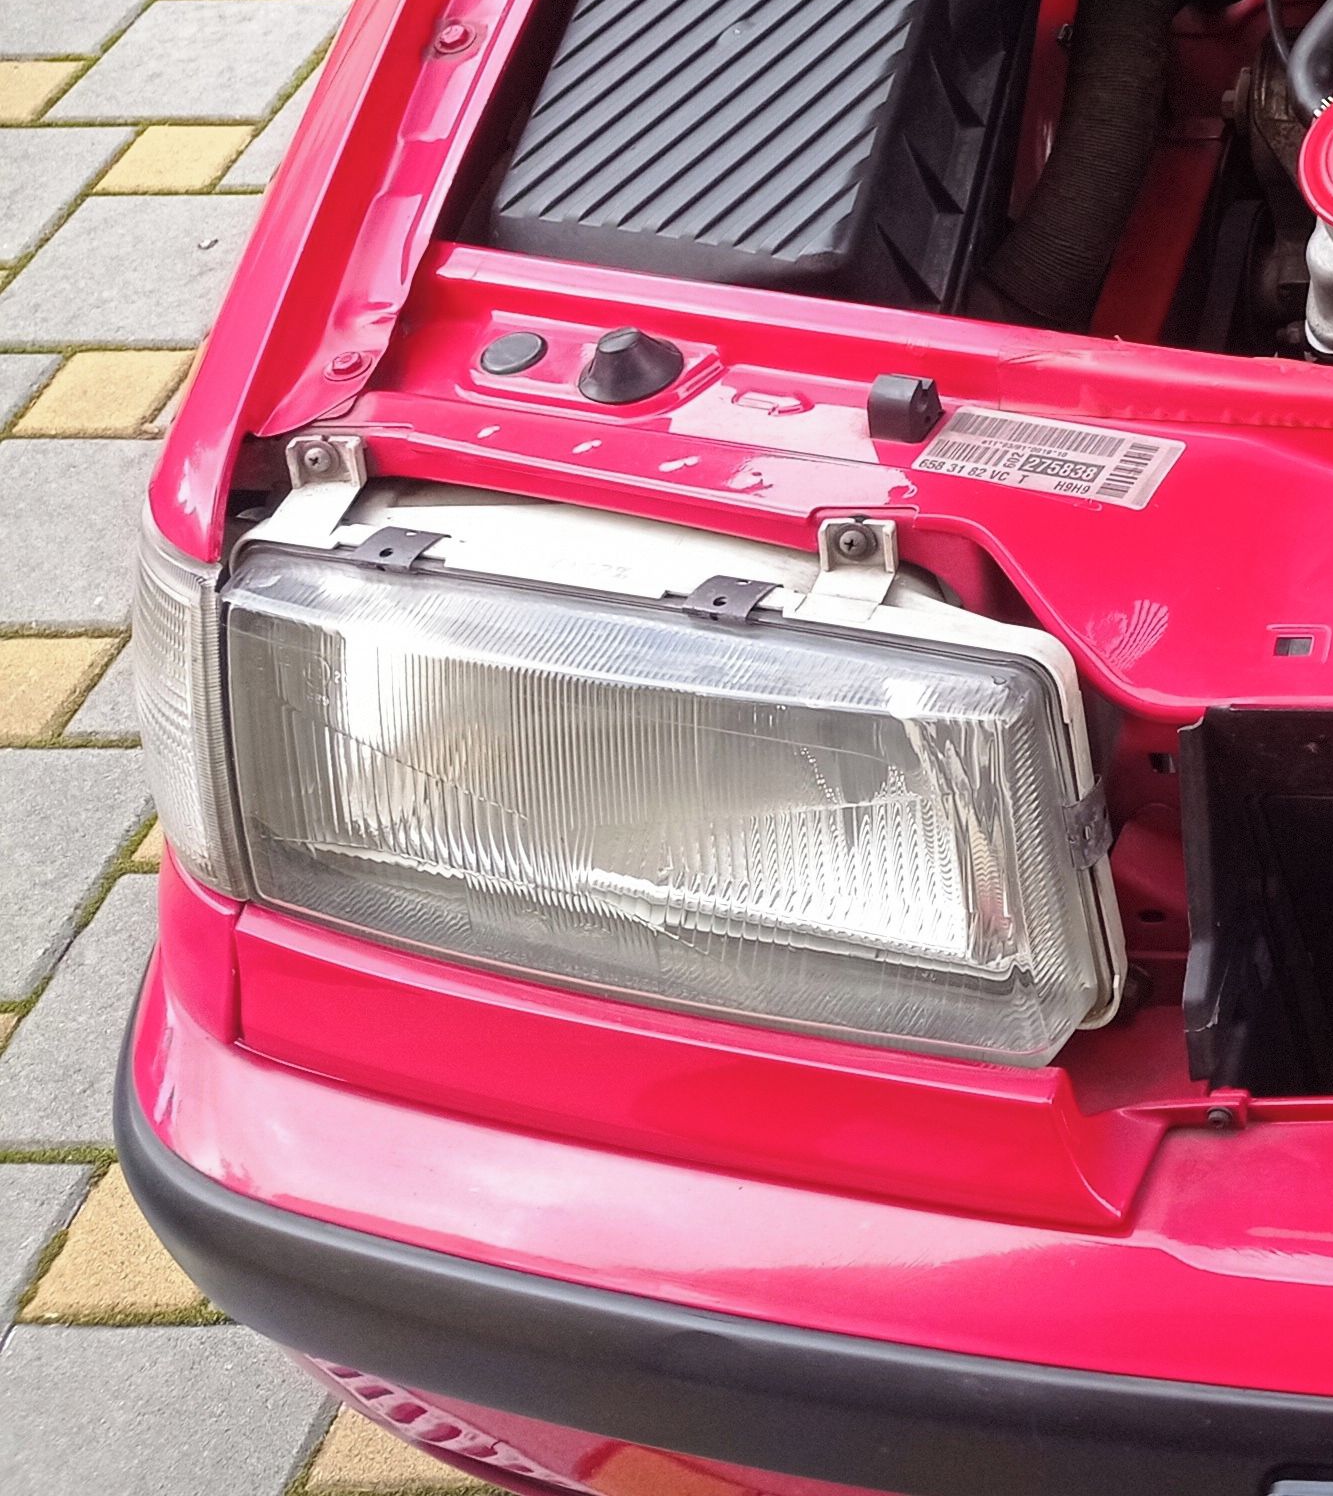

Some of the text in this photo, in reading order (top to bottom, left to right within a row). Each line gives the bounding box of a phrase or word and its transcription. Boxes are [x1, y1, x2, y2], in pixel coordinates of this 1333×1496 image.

[918, 458, 944, 471] 658
[946, 462, 964, 474] 31
[990, 469, 1010, 482] VC
[1017, 474, 1030, 485] T
[1053, 480, 1092, 496] H9H9
[1025, 457, 1098, 481] 275838
